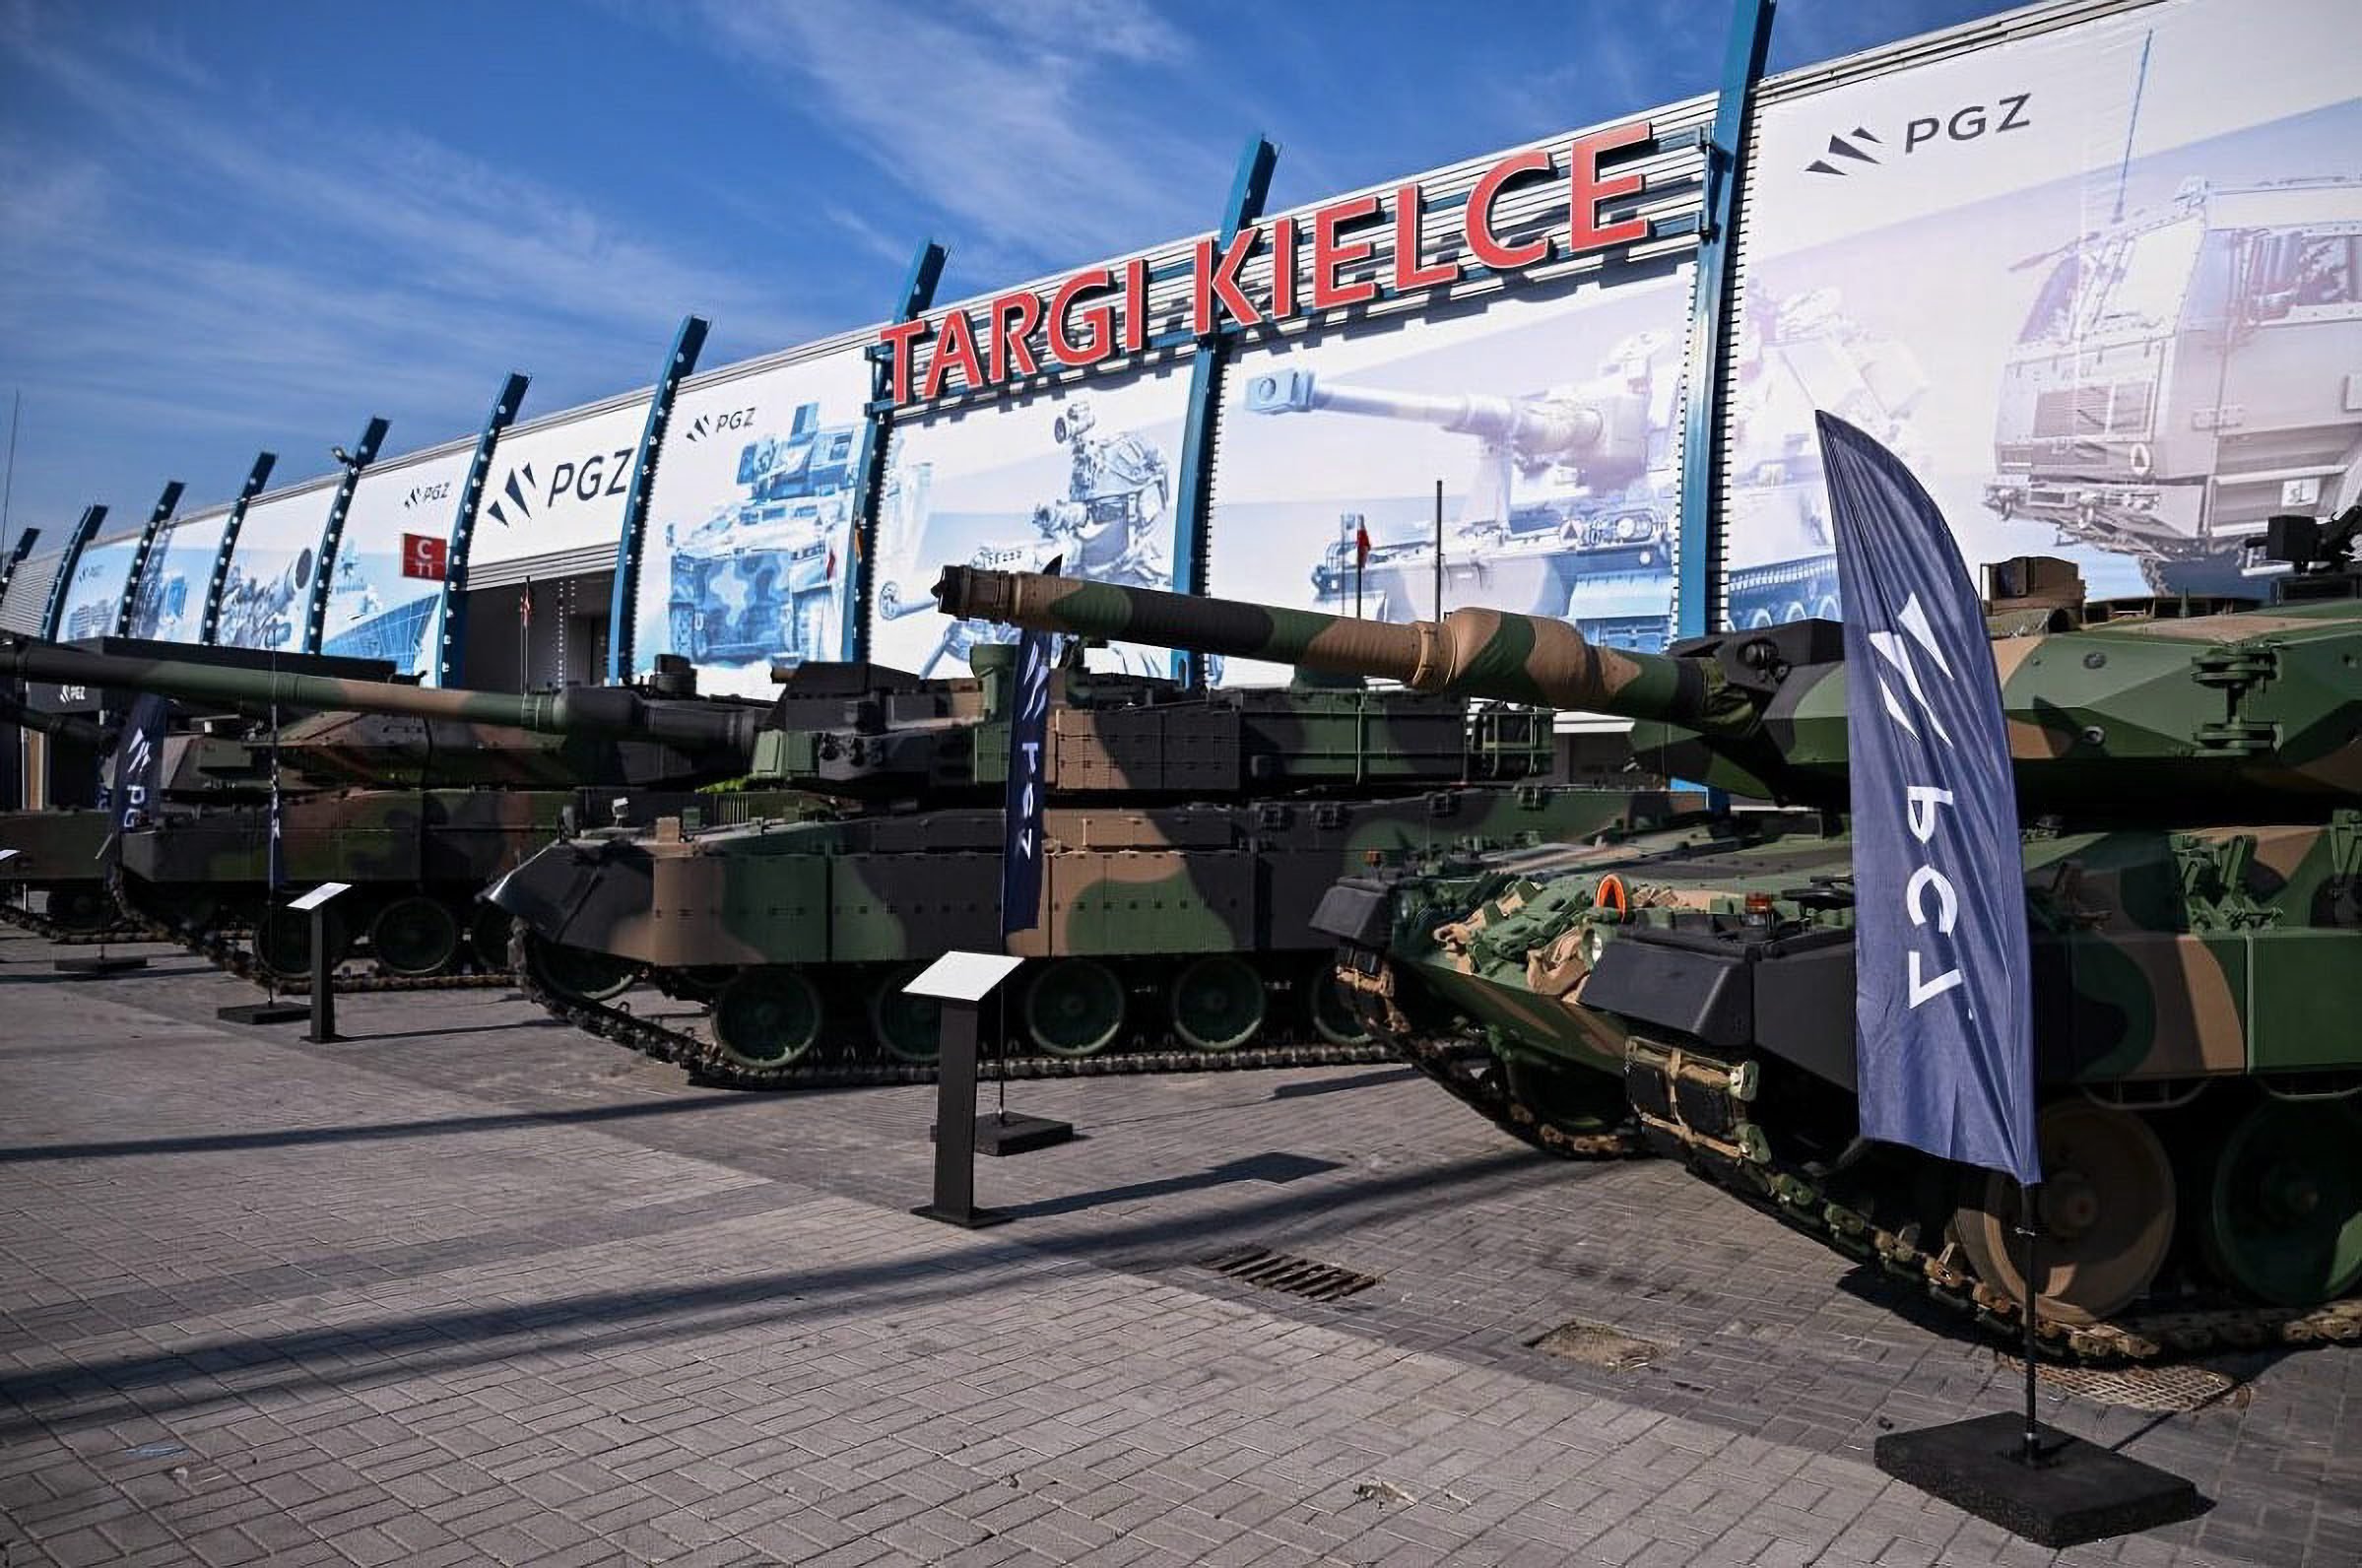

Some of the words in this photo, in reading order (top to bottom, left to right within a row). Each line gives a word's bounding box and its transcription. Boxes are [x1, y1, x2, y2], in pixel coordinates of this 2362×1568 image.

[1904, 92, 2032, 154] PGZ
[880, 258, 1149, 405] TARGI
[1192, 121, 1654, 336] KIELCE
[715, 406, 756, 433] PGZ
[423, 482, 450, 501] PGZ
[548, 447, 636, 509] PGZ
[417, 539, 433, 559] C
